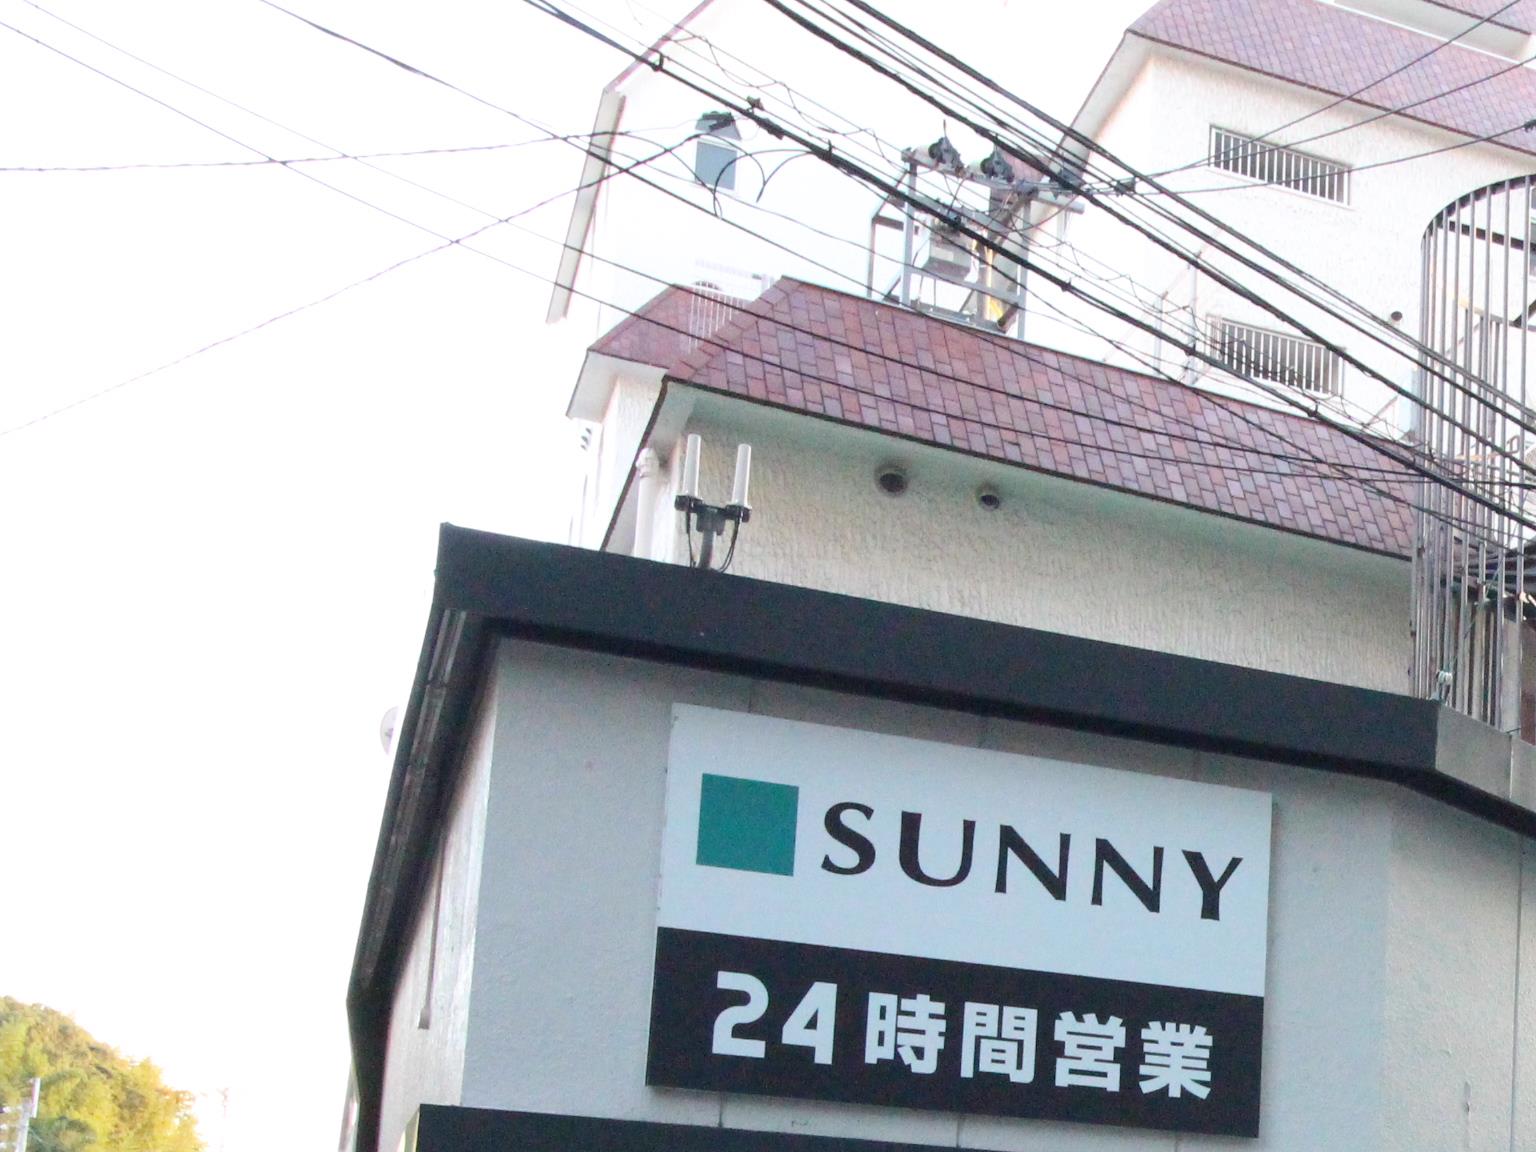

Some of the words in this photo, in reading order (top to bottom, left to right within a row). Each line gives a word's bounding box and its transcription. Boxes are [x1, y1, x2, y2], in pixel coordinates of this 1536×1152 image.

[820, 801, 1243, 921] SUNNY
[711, 970, 1213, 1100] 24時間営業
